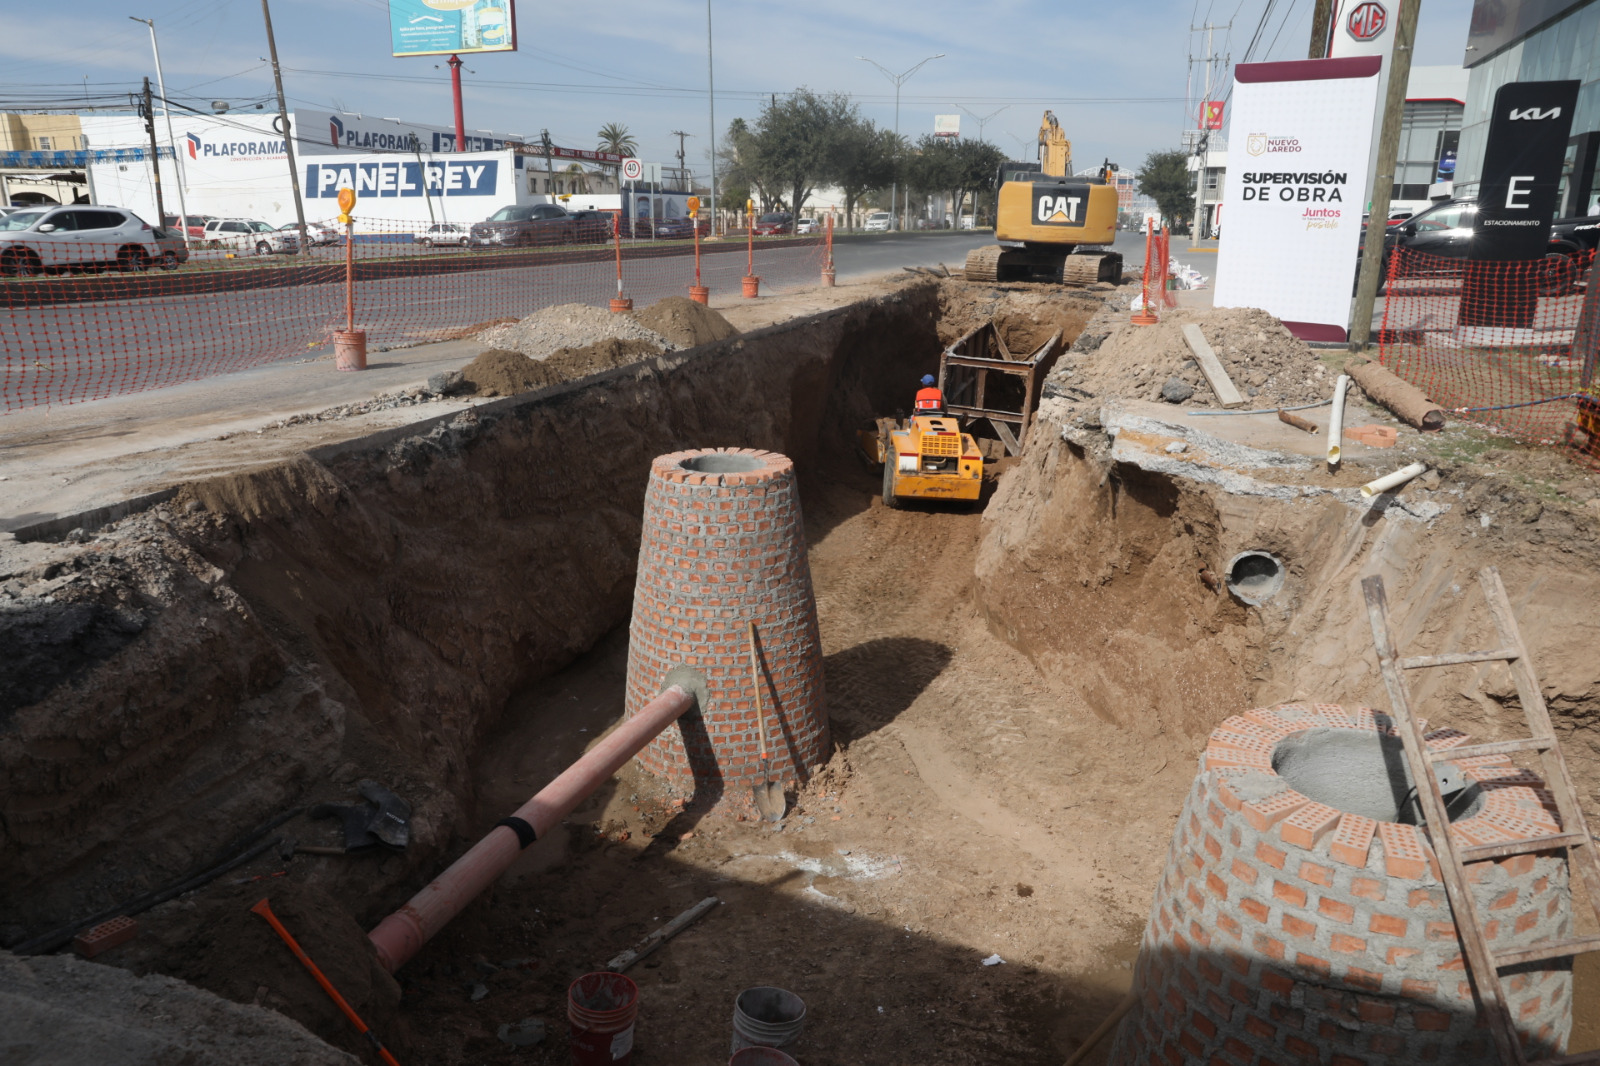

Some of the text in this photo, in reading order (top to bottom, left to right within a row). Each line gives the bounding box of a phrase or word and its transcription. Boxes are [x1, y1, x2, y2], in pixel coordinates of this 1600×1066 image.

[1350, 4, 1385, 37] MG
[1509, 106, 1562, 121] KIA
[203, 141, 289, 157] PLAFORAMA
[627, 163, 637, 172] 40
[319, 165, 486, 192] PANEL REY
[1242, 170, 1347, 185] SUPERVISIÓN
[1242, 186, 1343, 202] DE OBRA
[1504, 175, 1535, 209] E
[1037, 195, 1082, 223] CAT
[1302, 207, 1341, 218] Juntos
[1306, 218, 1339, 231] posible
[1483, 219, 1541, 227] ESTACIONAMIENTO
